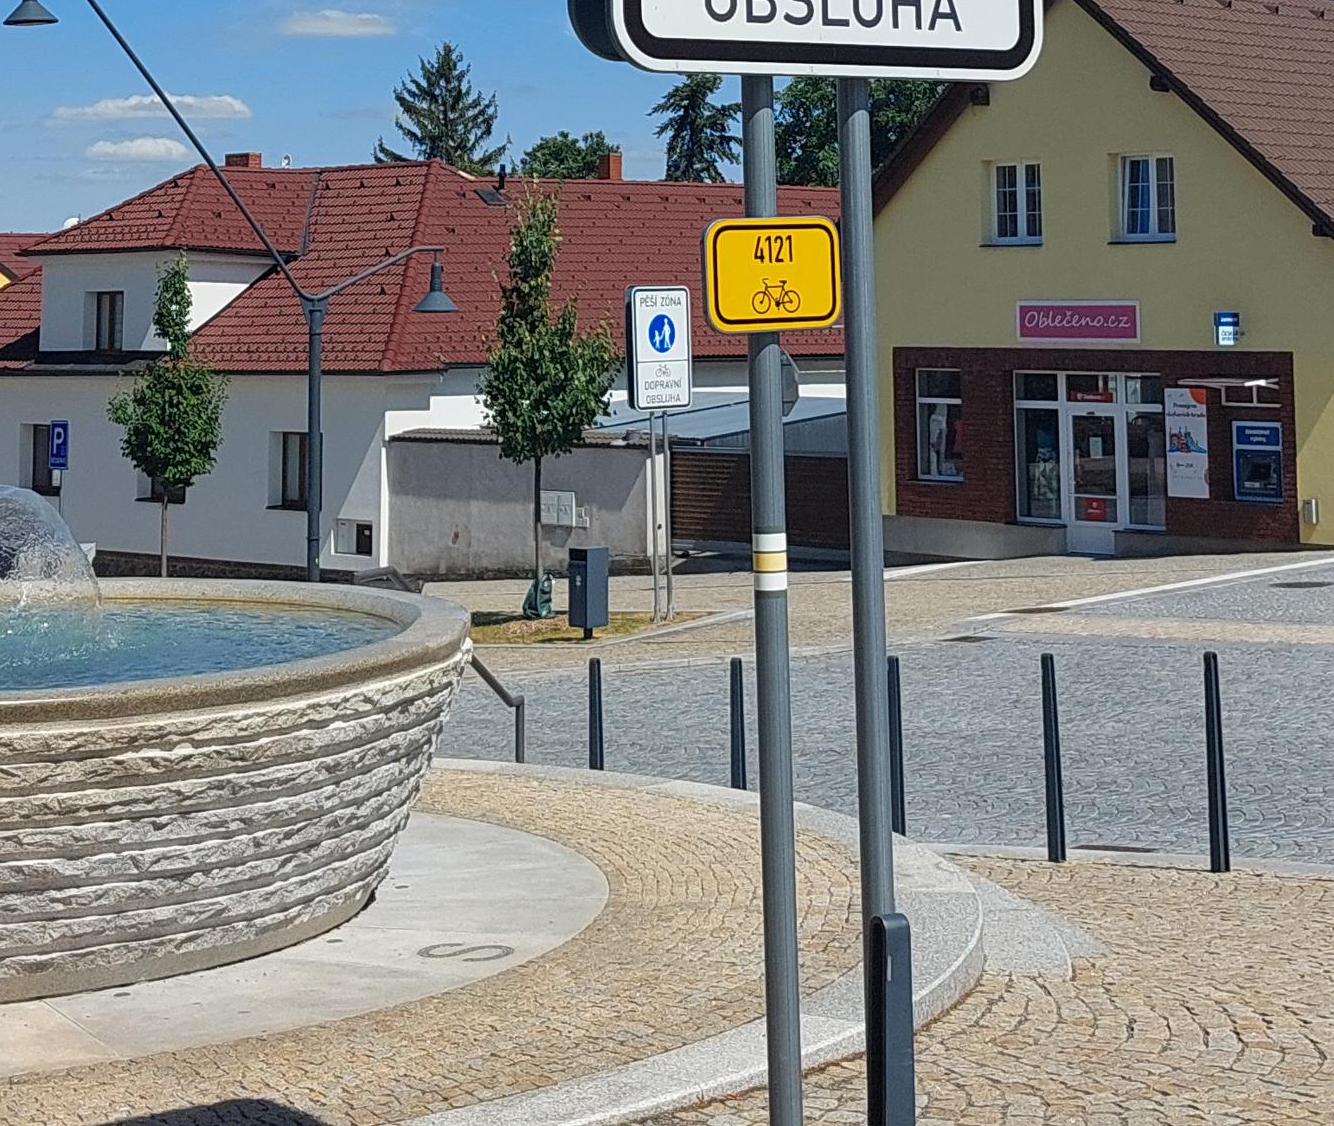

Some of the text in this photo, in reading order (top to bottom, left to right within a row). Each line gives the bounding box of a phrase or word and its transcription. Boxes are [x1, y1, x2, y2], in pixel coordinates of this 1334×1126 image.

[753, 234, 794, 265] 4121
[639, 294, 682, 308] PĚŠÍ ZÓNA
[1024, 310, 1131, 328] Oblečeno.cz
[644, 378, 682, 391] DOPRAVNÍ
[645, 393, 682, 405] OBSLUHA
[52, 427, 65, 454] P
